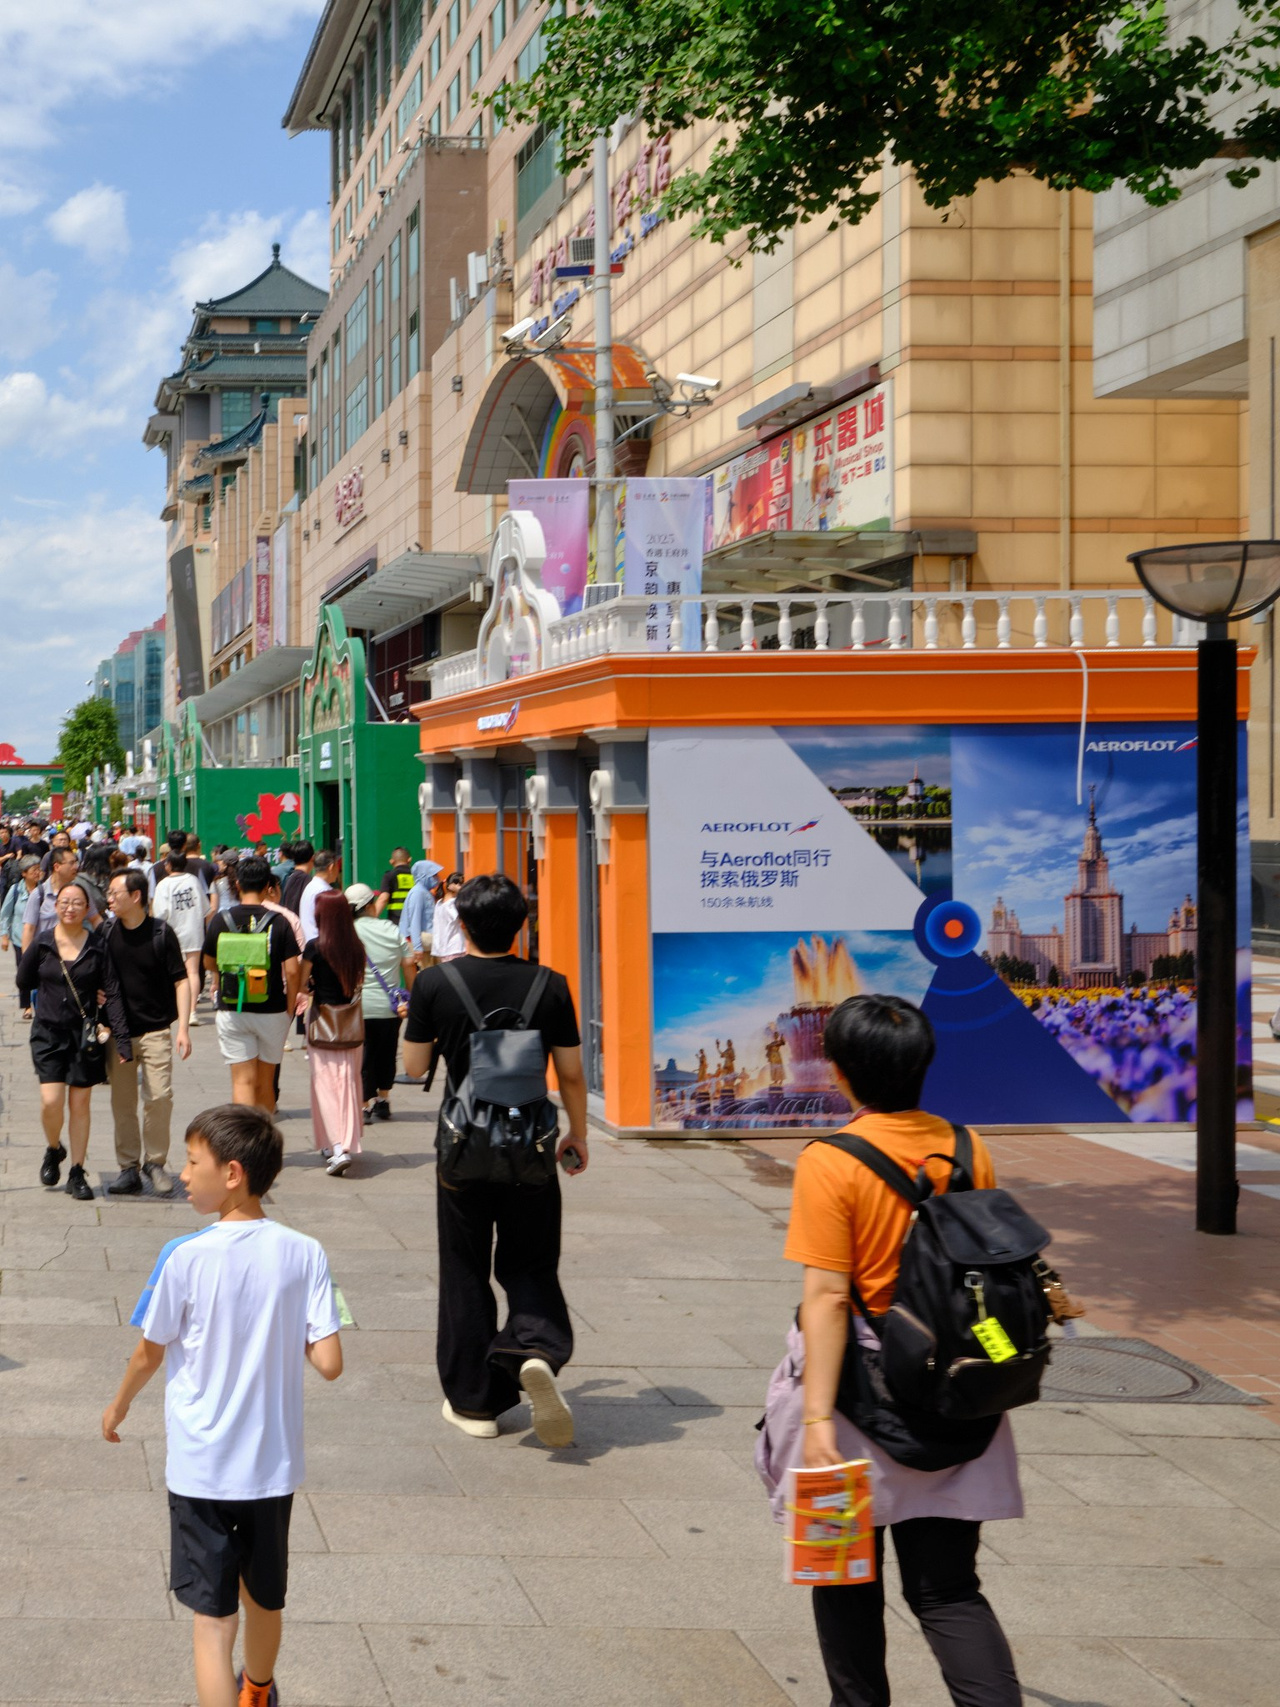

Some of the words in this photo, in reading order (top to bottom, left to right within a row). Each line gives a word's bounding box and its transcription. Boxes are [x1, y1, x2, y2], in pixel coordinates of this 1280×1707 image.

[813, 393, 885, 462] 乐器城
[833, 450, 863, 471] Musical
[864, 442, 884, 459] Shop
[874, 456, 886, 473] B2
[646, 533, 675, 545] 2025
[1085, 740, 1177, 753] AEROFLOT
[700, 822, 792, 833] AEROFLOT
[699, 850, 832, 868] 与Aeroflot同行
[700, 869, 800, 889] 探索俄罗斯
[700, 896, 774, 908] 150余条航线
